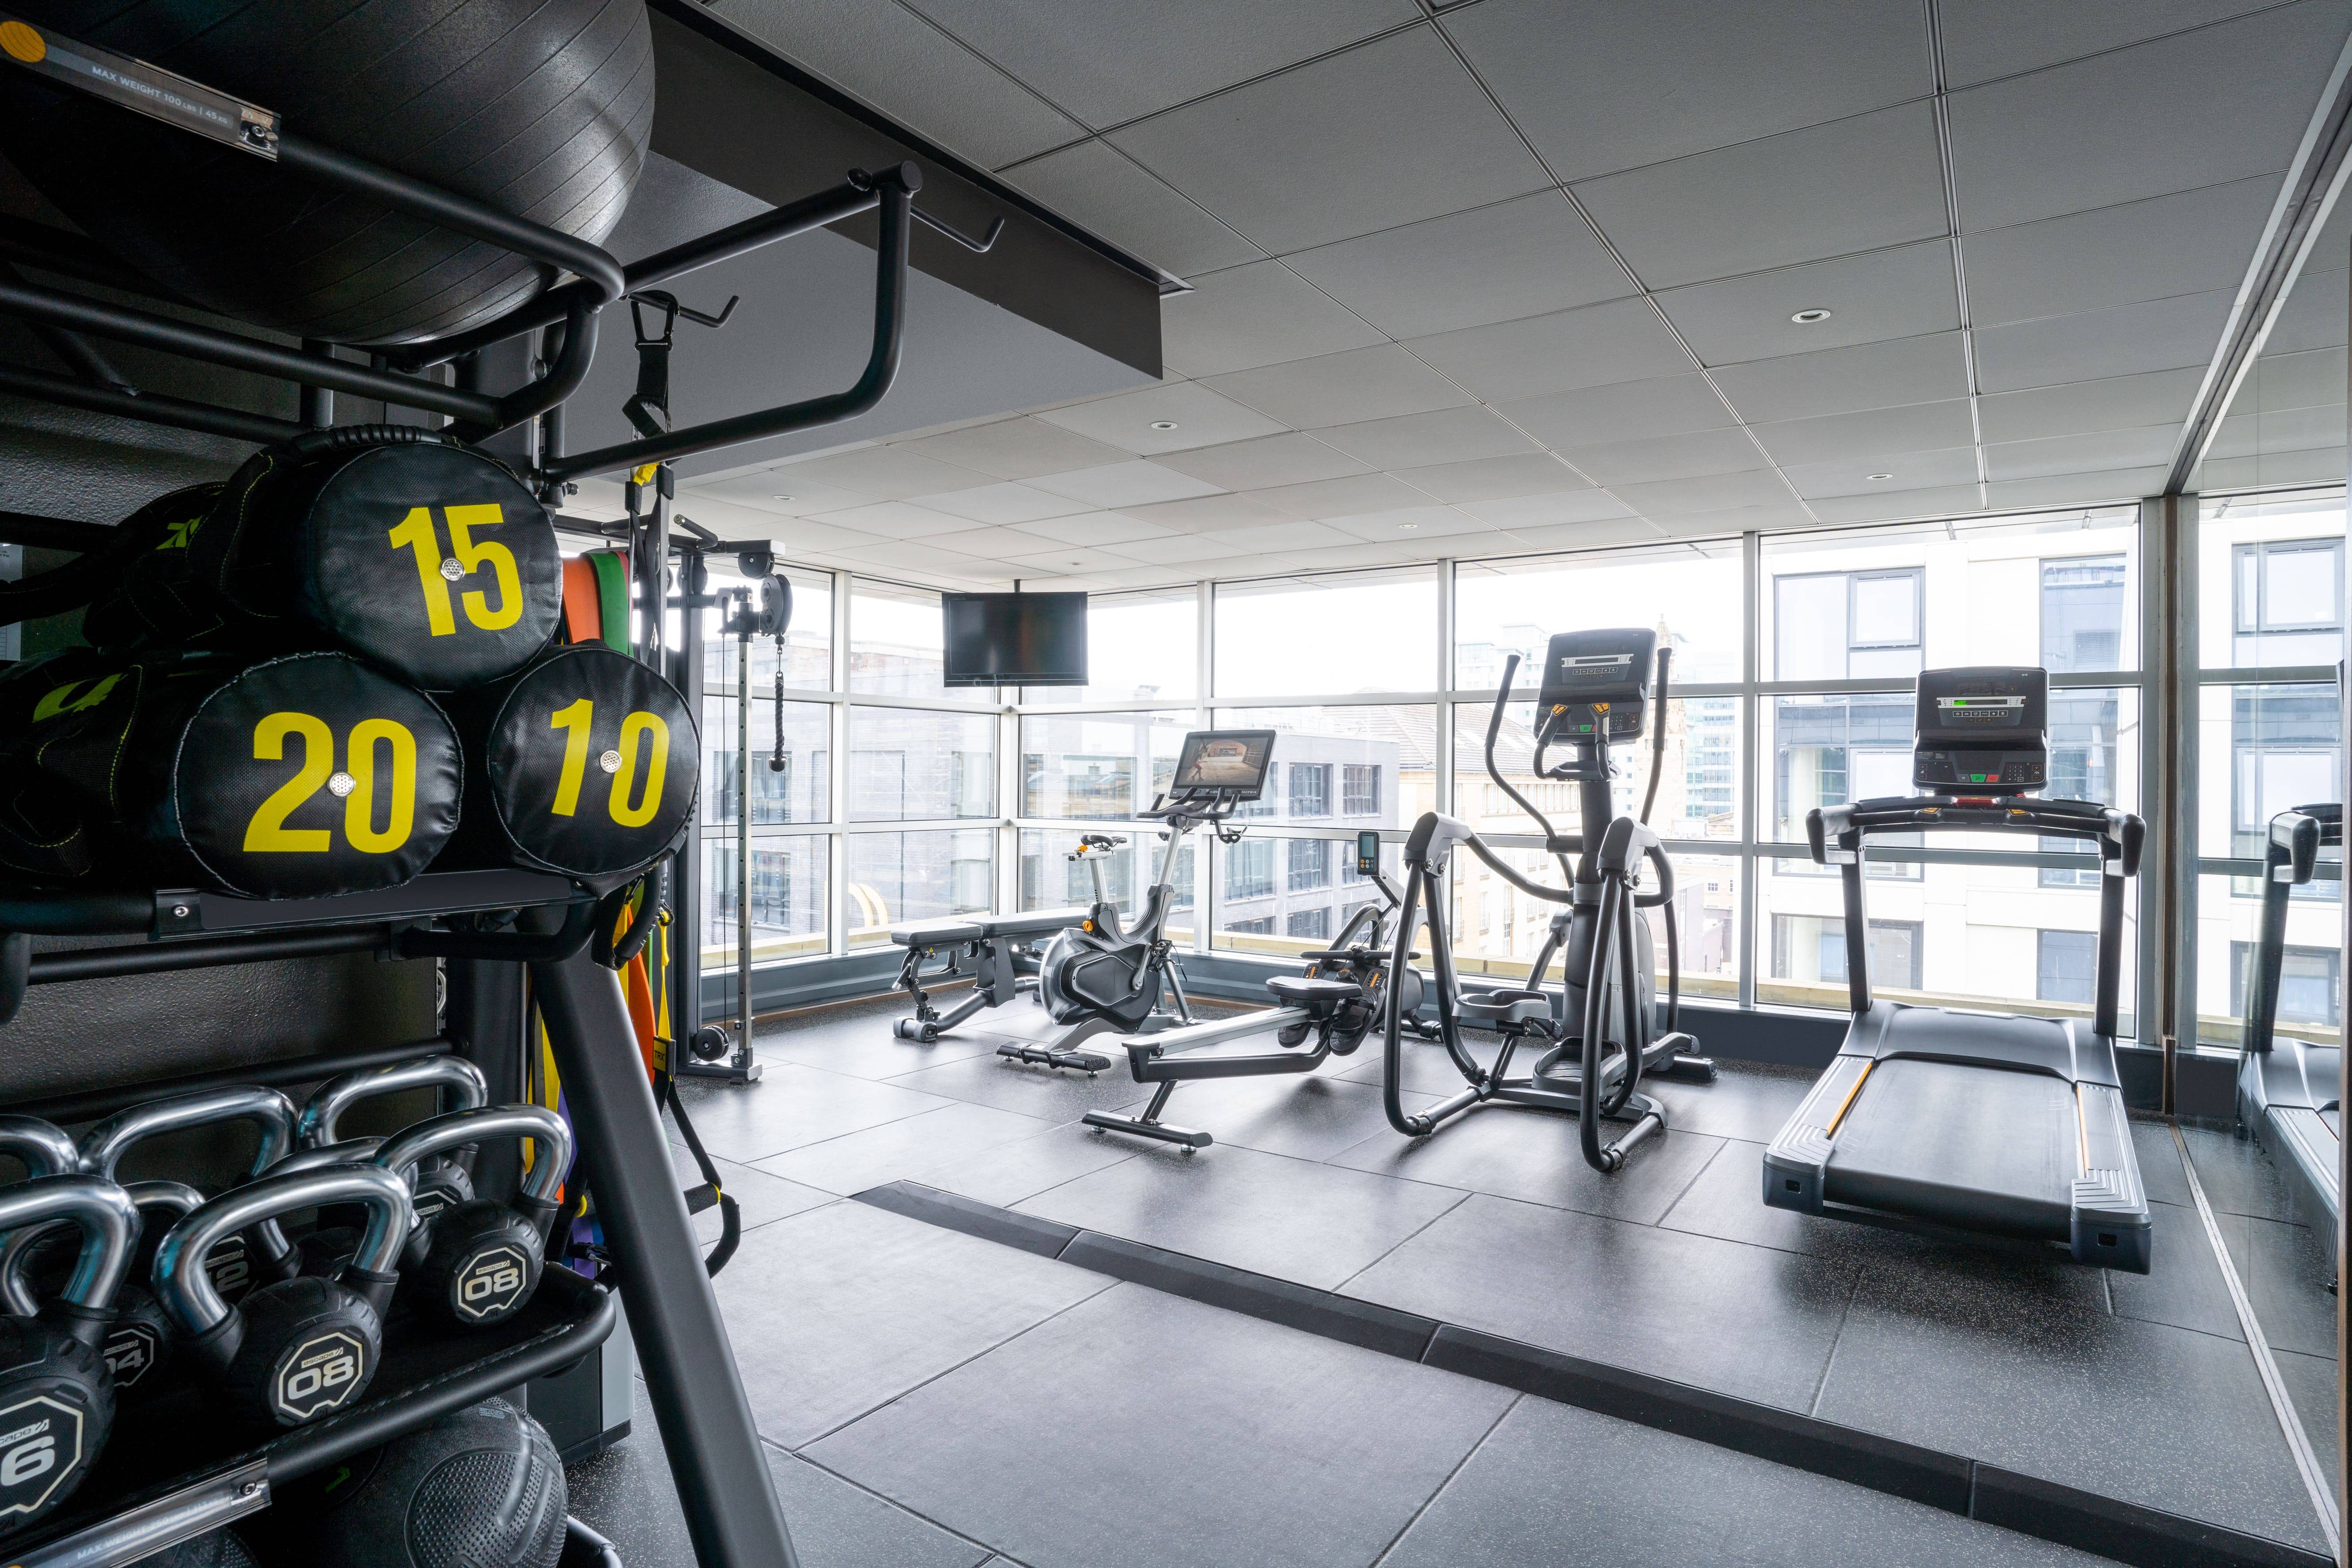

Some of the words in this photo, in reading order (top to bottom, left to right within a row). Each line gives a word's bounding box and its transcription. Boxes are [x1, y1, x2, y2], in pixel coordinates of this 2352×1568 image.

[92, 66, 116, 81] MAX
[120, 77, 161, 97] WEIGHT
[164, 94, 181, 106] 100
[183, 103, 196, 112] LBS
[205, 110, 217, 119] 45
[389, 503, 523, 636] 15
[551, 698, 670, 827] 10
[243, 712, 416, 853] 20
[654, 1050, 665, 1061] TRX
[205, 1254, 233, 1266] scape
[477, 1263, 502, 1273] escape
[207, 1261, 248, 1293] 2
[465, 1267, 519, 1301] 08
[104, 1344, 128, 1353] scape
[303, 1352, 334, 1366] escape
[288, 1355, 354, 1400] 08
[0, 1428, 31, 1445] cape
[1, 1435, 55, 1487] 6
[77, 1543, 102, 1560] MAX
[106, 1528, 146, 1548] WEIGHT
